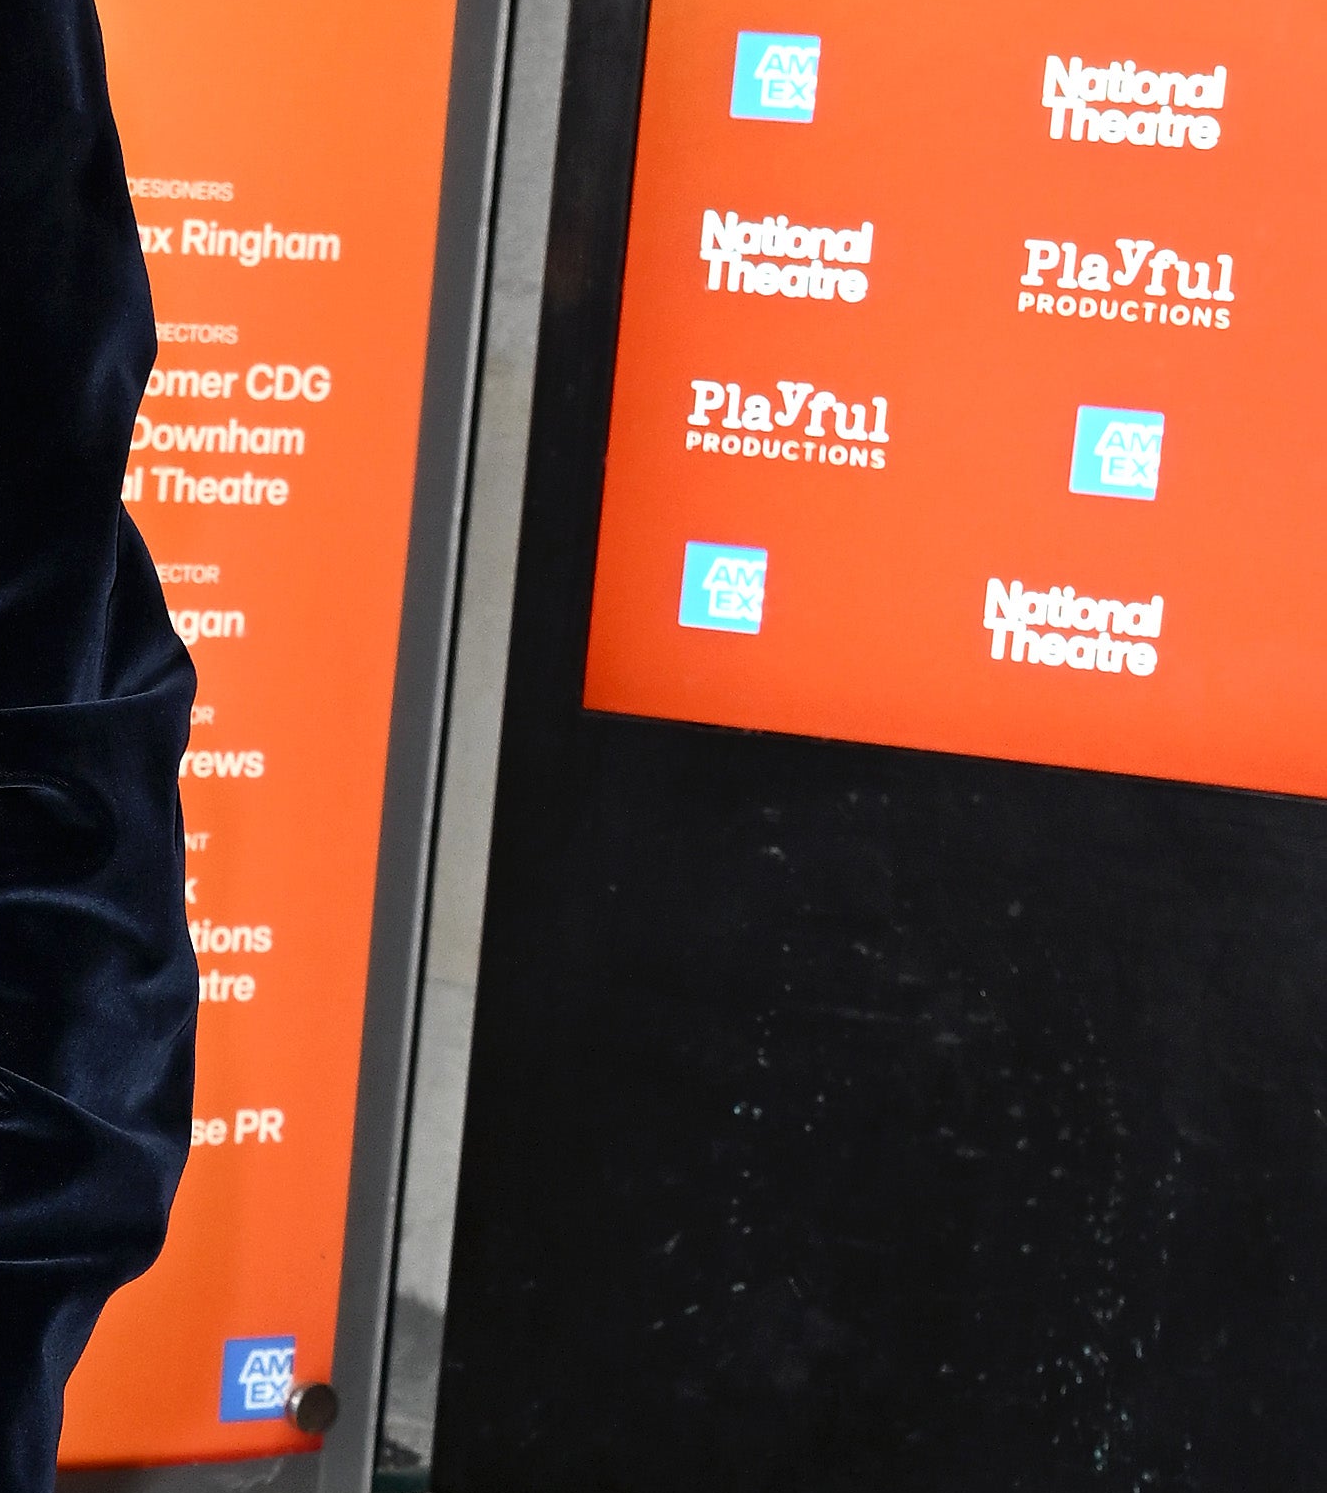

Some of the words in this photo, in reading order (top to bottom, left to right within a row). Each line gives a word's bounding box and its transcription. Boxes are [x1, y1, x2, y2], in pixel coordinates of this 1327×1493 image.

[1042, 56, 1227, 111] National
[1042, 100, 1223, 149] Theatre
[182, 219, 340, 266] Ringham
[700, 210, 873, 265] National
[700, 254, 871, 302] Theatre
[1019, 239, 1235, 301] Playful
[1017, 291, 1231, 329] PRODUCTIONS
[145, 368, 238, 398] omer
[246, 364, 330, 401] CDG
[130, 414, 304, 454] Downham
[687, 380, 890, 443] Playful
[685, 430, 887, 469] PRODUCTIONS
[151, 467, 288, 505] Theatre
[983, 578, 1164, 642] National
[983, 621, 1161, 676] Theatre
[179, 751, 264, 777] rews
[235, 1109, 283, 1143] PR
